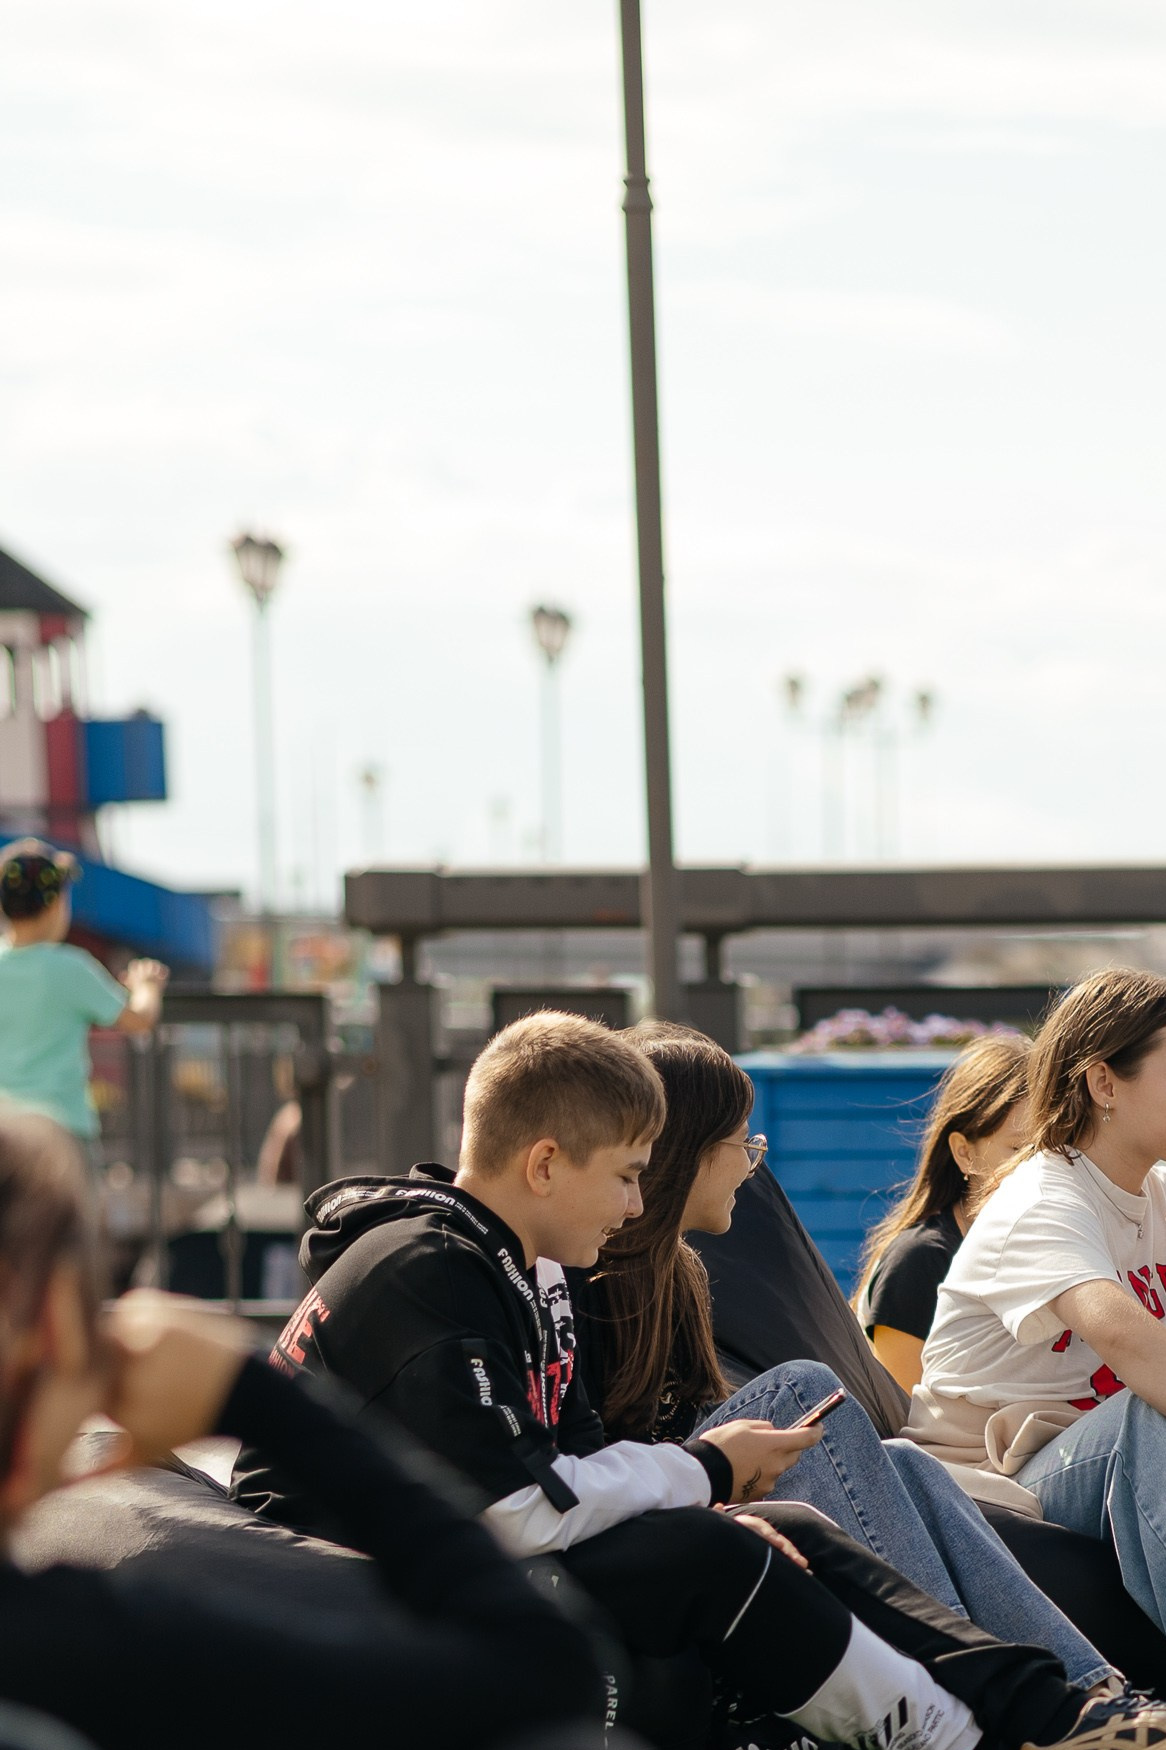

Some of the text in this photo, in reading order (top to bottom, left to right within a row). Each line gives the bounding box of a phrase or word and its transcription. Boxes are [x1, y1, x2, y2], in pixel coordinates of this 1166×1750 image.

[497, 1247, 534, 1301] FASHION
[470, 1358, 493, 1406] FASHIO
[603, 1674, 619, 1731] PAREL
